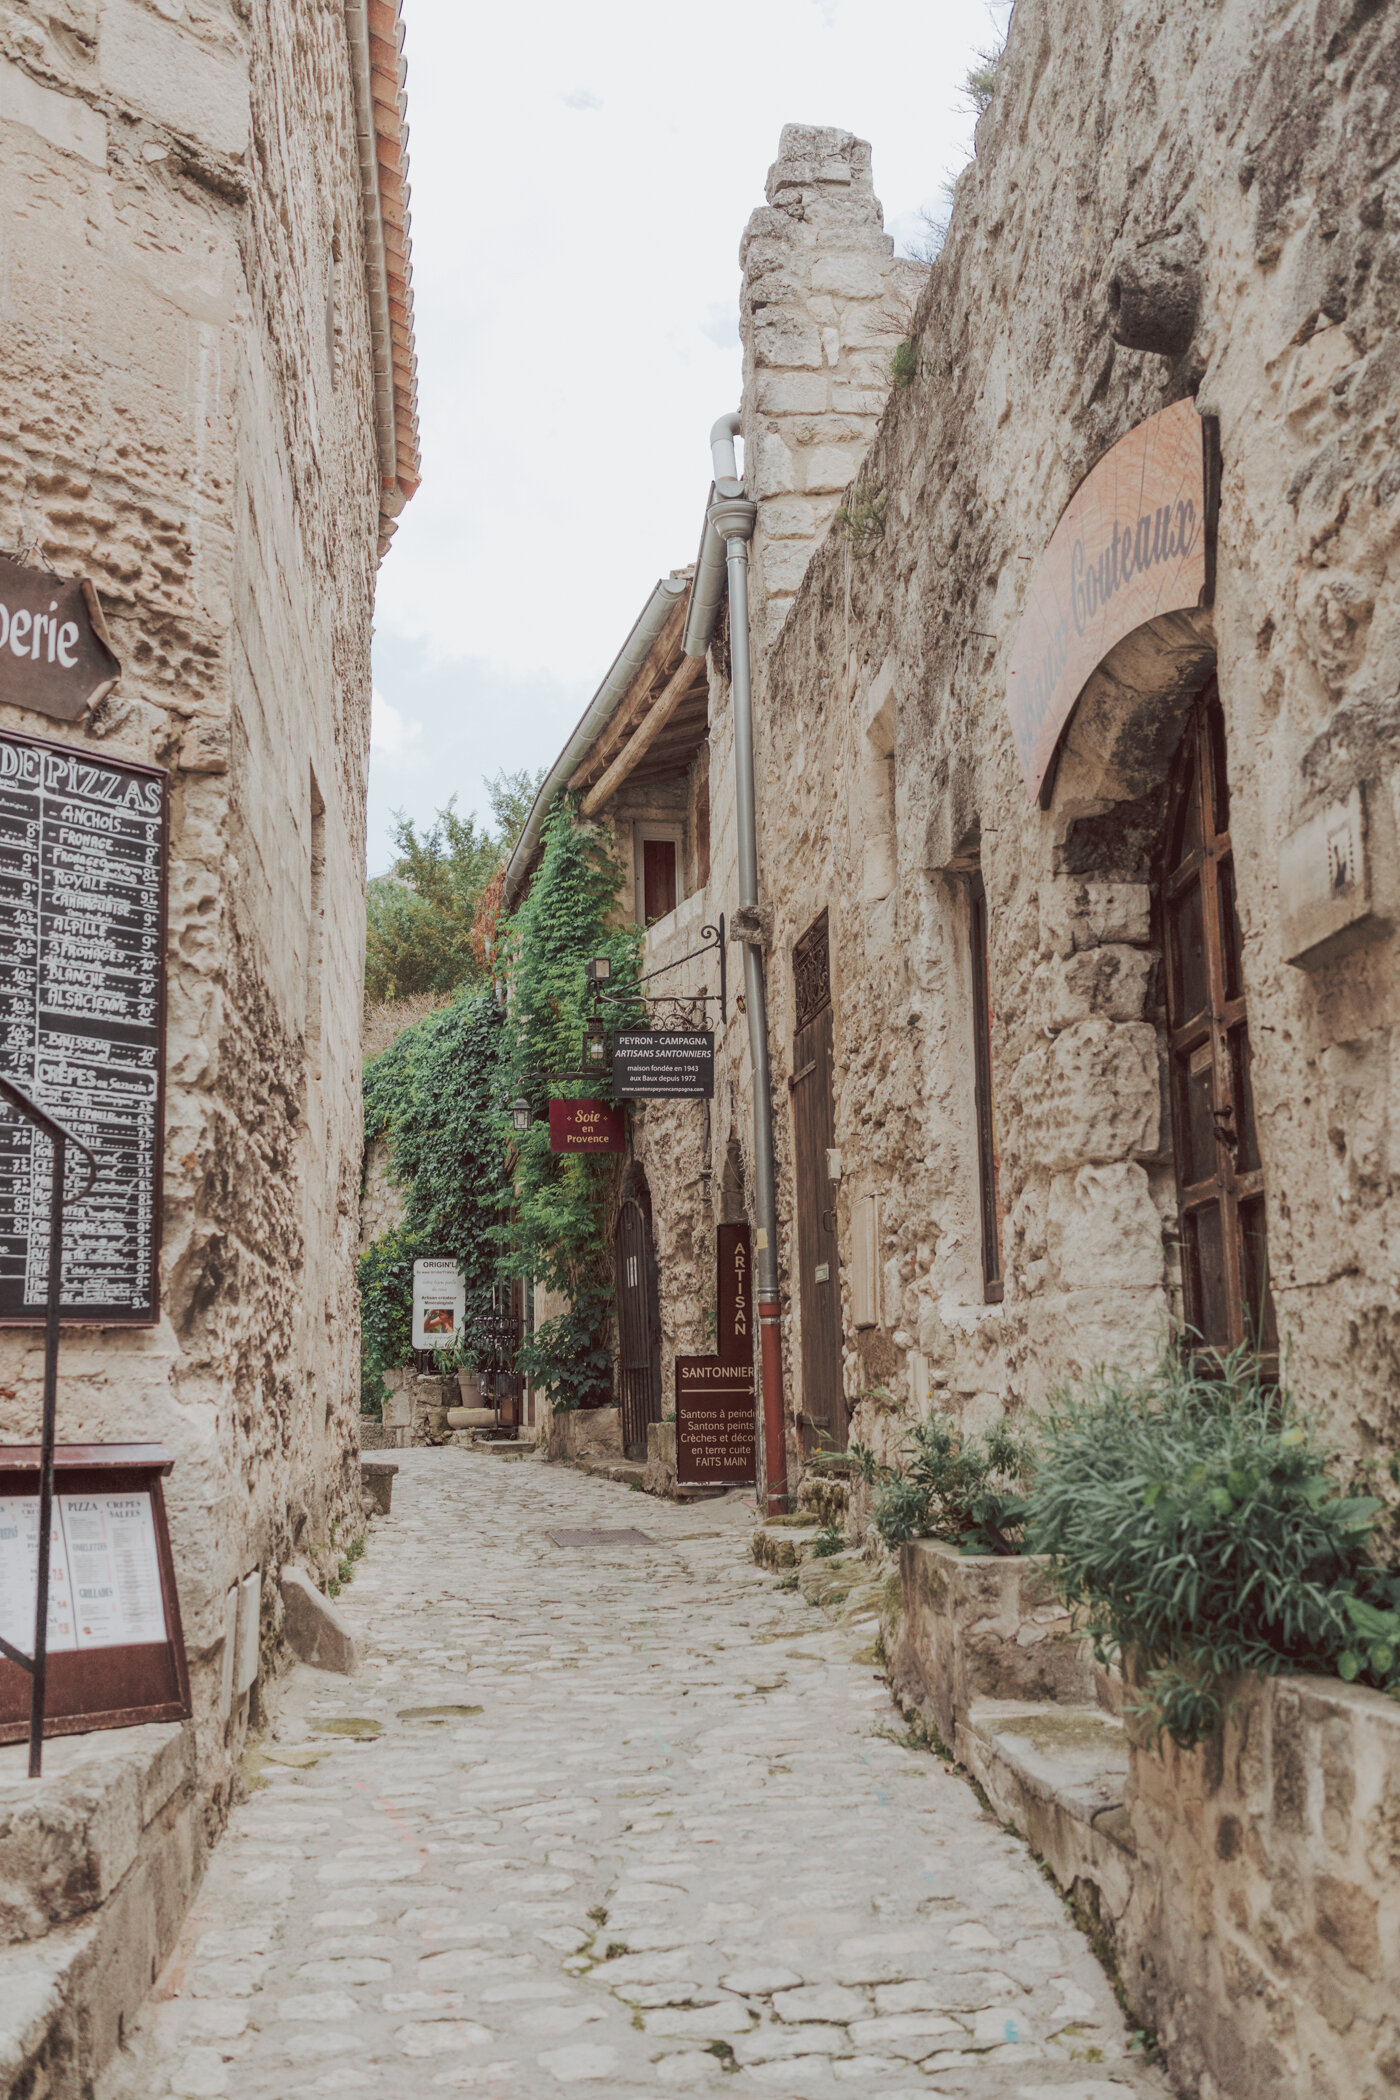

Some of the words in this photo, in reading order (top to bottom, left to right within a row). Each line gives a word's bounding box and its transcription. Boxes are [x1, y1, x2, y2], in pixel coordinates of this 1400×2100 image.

[1070, 497, 1196, 637] Couteaux
[61, 942, 126, 963] FROMAGES
[46, 963, 107, 987] BLANCHE
[619, 1036, 653, 1045] PEYRON
[659, 1036, 708, 1046] CAMPAGNA
[615, 1049, 655, 1059] ARTISANS
[655, 1049, 712, 1059] SANTONNIERS
[39, 1060, 97, 1088] CRÊPES
[650, 1064, 673, 1072] fondée
[683, 1064, 699, 1072] 1943
[641, 1074, 658, 1082] Baux
[658, 1074, 679, 1084] depuis
[680, 1074, 697, 1082] 1972
[621, 1085, 705, 1093] www.santonspeyroncampagna.com
[574, 1109, 602, 1124] Soie
[581, 1125, 594, 1133] en
[566, 1134, 610, 1144] Provence
[734, 1242, 747, 1336] ARTISAN
[681, 1366, 754, 1379] SANTONNIER
[680, 1408, 717, 1420] Santons
[719, 1409, 726, 1420] à
[687, 1420, 725, 1432] Santons
[727, 1421, 754, 1434] peints
[680, 1432, 717, 1444] Crèches
[719, 1434, 729, 1444] et
[731, 1432, 756, 1444] déco
[691, 1446, 703, 1455] en
[705, 1445, 727, 1455] terre
[728, 1444, 752, 1455] cuite
[695, 1456, 722, 1467] FAITS
[723, 1456, 747, 1467] MAIN
[67, 1502, 98, 1512] PIZZA
[79, 1587, 113, 1599] GRILLADES
